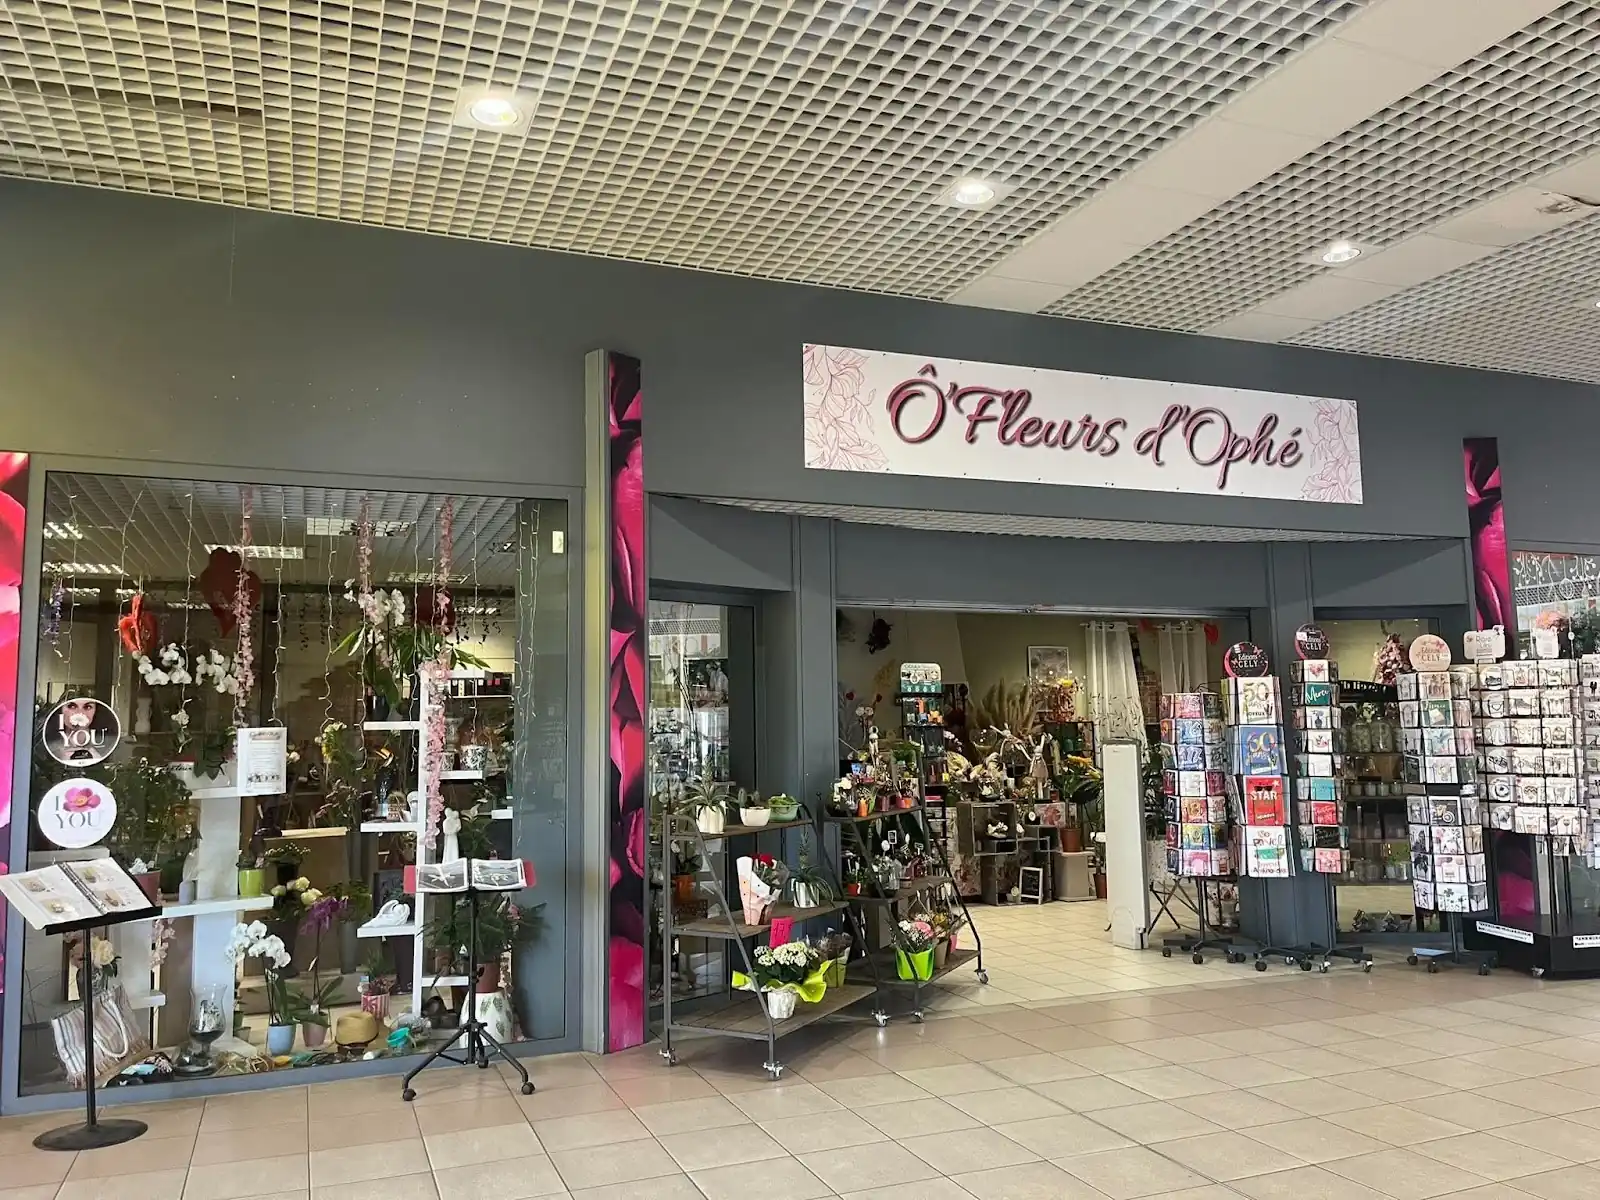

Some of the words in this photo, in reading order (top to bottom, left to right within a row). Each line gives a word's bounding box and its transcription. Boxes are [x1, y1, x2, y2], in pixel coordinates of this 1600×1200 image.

[885, 363, 1127, 457] Ô'Fleurs
[1133, 403, 1303, 490] d'Ophé
[1238, 660, 1259, 668] CELY
[58, 713, 65, 730] I
[59, 727, 107, 748] YOU
[55, 795, 60, 811] I
[1250, 790, 1279, 801] STAR
[54, 812, 101, 829] YOU
